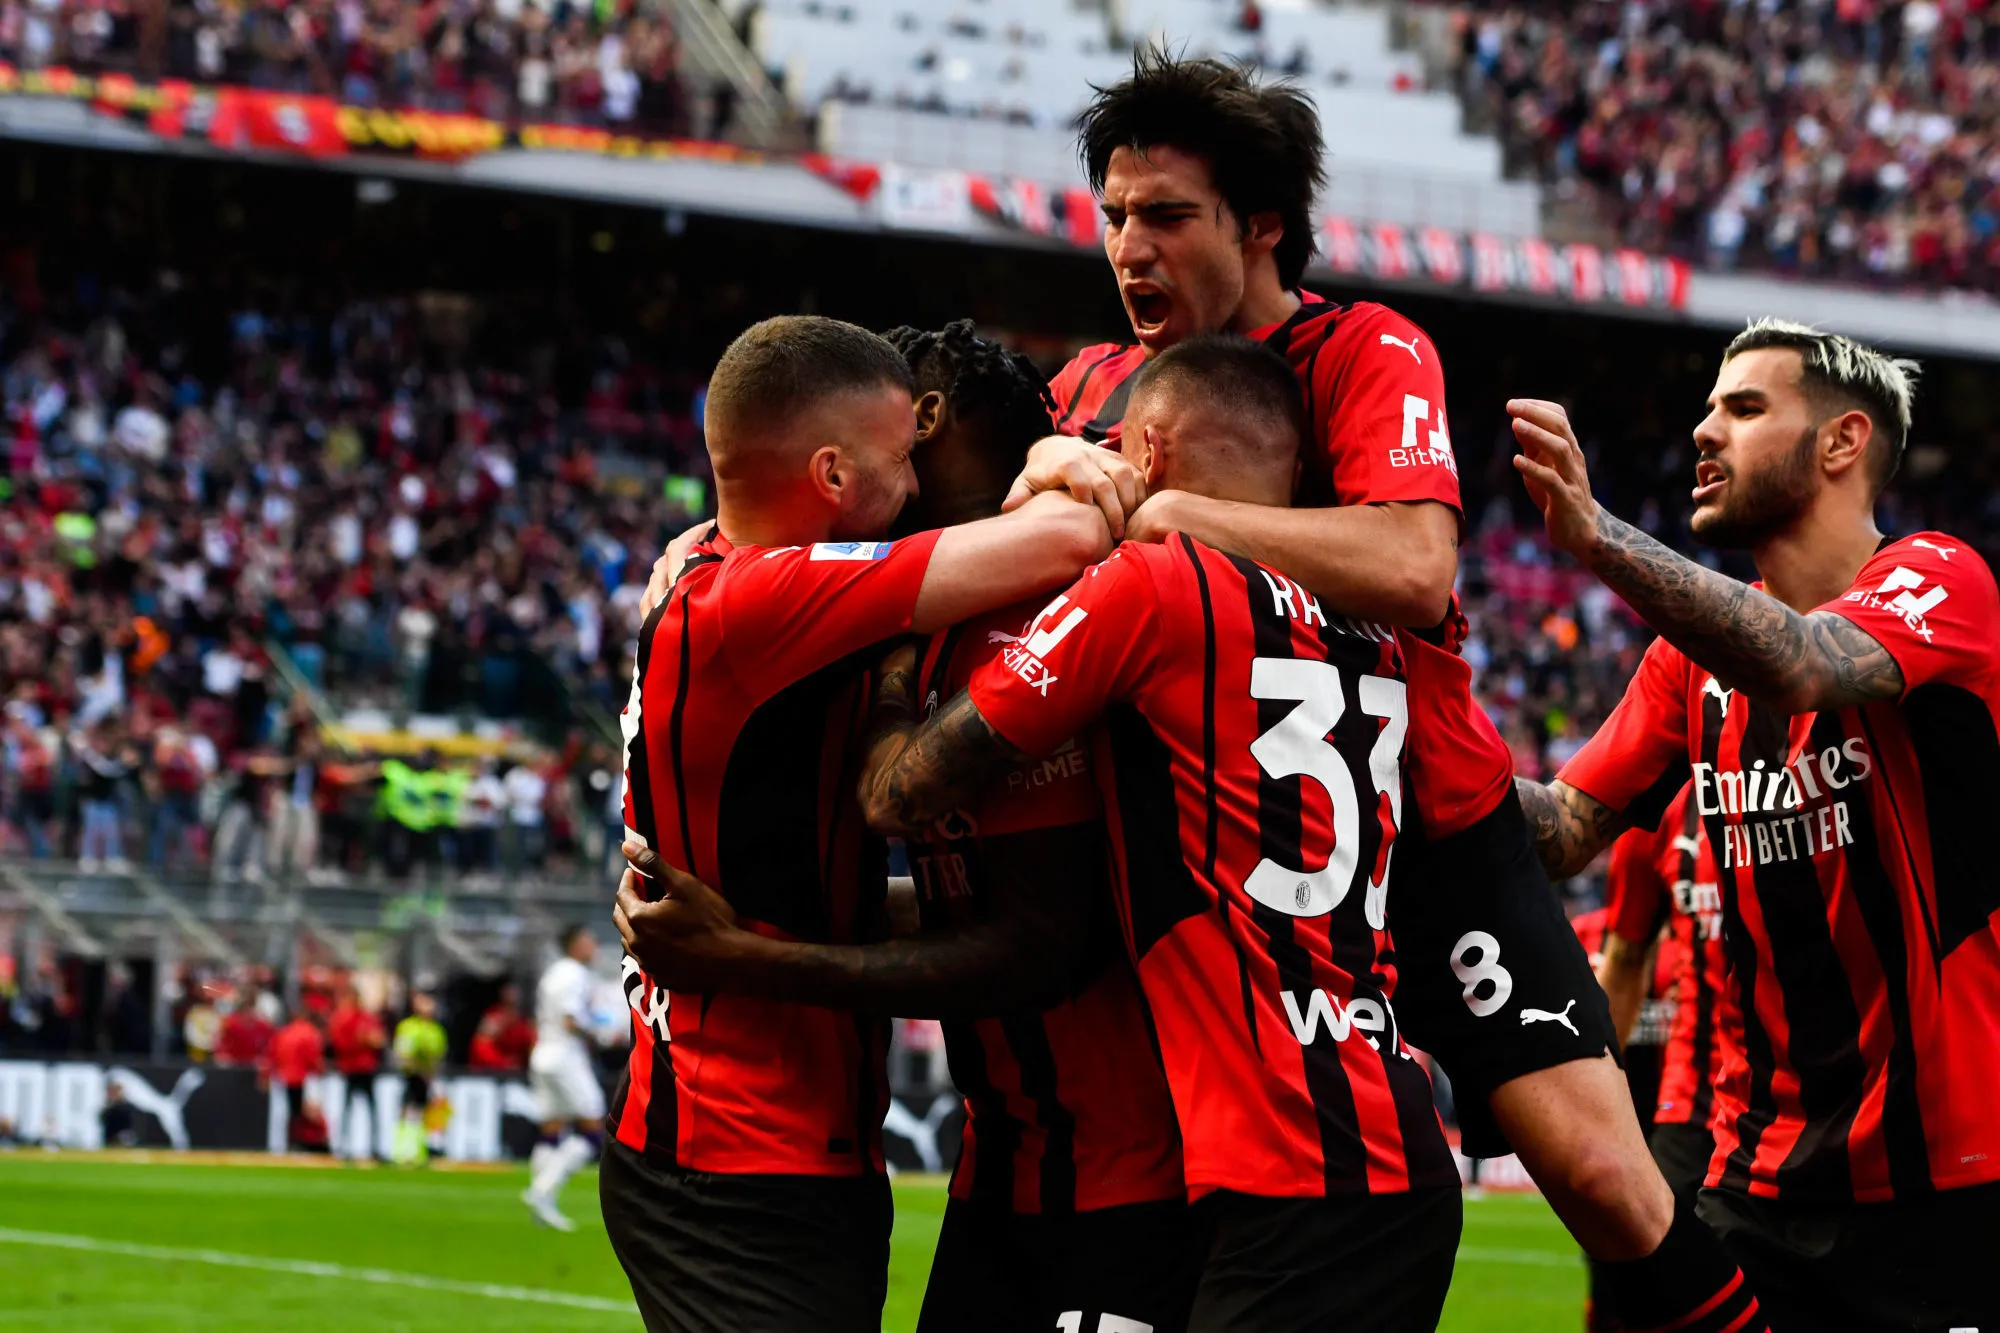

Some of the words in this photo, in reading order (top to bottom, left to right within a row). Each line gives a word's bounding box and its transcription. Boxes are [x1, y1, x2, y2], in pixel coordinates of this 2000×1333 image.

[1843, 591, 1934, 643] BitMEX
[1244, 656, 1409, 931] 33
[1692, 737, 1872, 815] Emirates
[1723, 824, 1752, 868] FLY
[1754, 801, 1855, 865] BETTER
[1450, 930, 1513, 1017] 8
